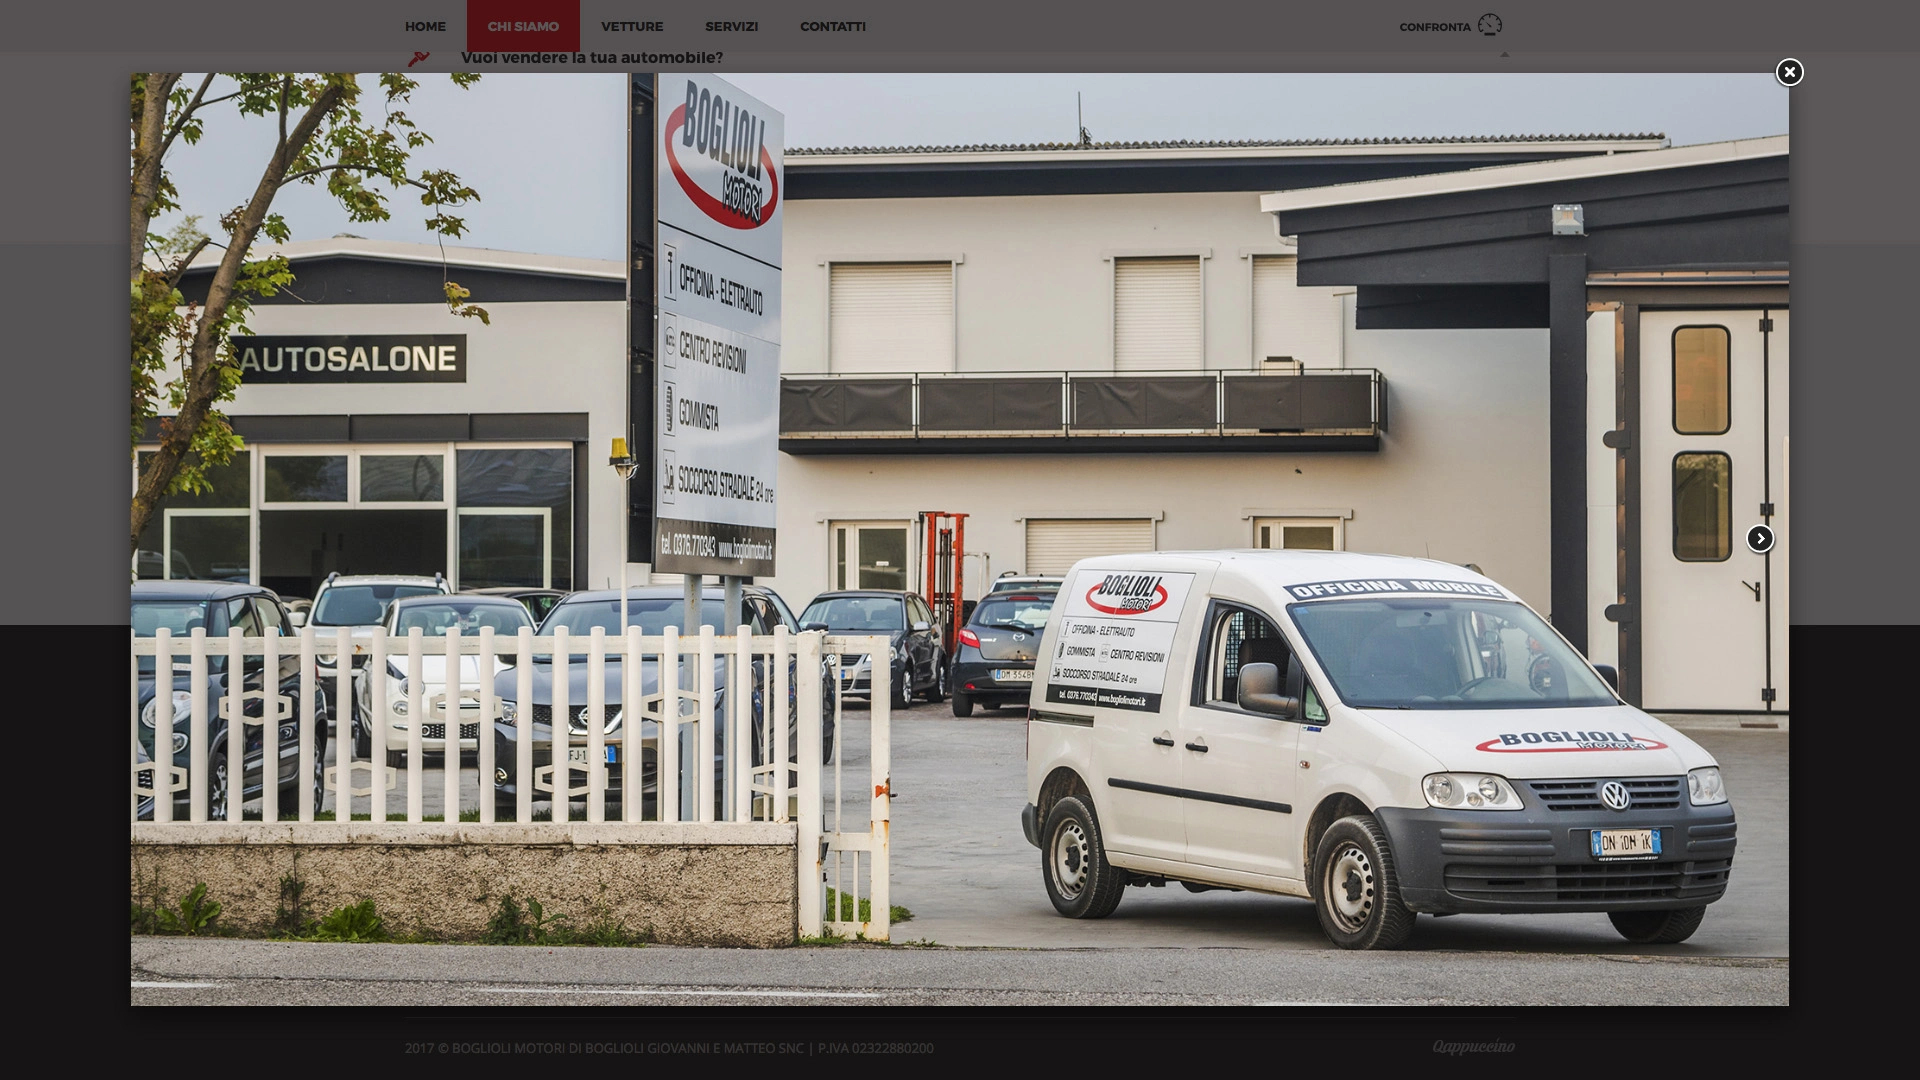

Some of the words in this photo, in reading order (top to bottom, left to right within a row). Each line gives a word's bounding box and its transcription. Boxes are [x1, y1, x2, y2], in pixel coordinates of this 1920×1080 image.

[682, 79, 765, 182] BOGLIOLI
[722, 170, 763, 226] MOTORI
[679, 263, 715, 300] OFFICINA
[720, 277, 763, 316] ELETTRAUTO
[241, 345, 457, 372] AUTOSALONE
[679, 331, 710, 365] CENTRO
[712, 340, 747, 374] REVISIONI
[679, 398, 719, 431] GOMMISTA
[679, 465, 718, 496] SOCCORSO
[720, 471, 754, 501] STRADALE
[756, 481, 763, 500] 24
[765, 487, 774, 504] ore
[661, 532, 671, 555] tel.
[673, 533, 716, 557] 0376.770343
[719, 537, 772, 565] www.bogliolimotori.it
[1097, 574, 1163, 598] BOGLIOLI
[1292, 580, 1408, 598] OFFICINA
[1413, 580, 1501, 597] MOBILE
[1119, 597, 1153, 612] MOTORI
[1072, 624, 1096, 634] OFFICINA
[1099, 625, 1135, 637] ELETTRAUTO
[1066, 646, 1096, 657] GOMMISTA
[1110, 649, 1135, 660] CENTRO
[1134, 650, 1165, 663] REVISIONI
[1062, 668, 1091, 680] SOCCORSO
[1091, 670, 1120, 682] STRADALE
[1500, 731, 1636, 746] BOGLIOLI
